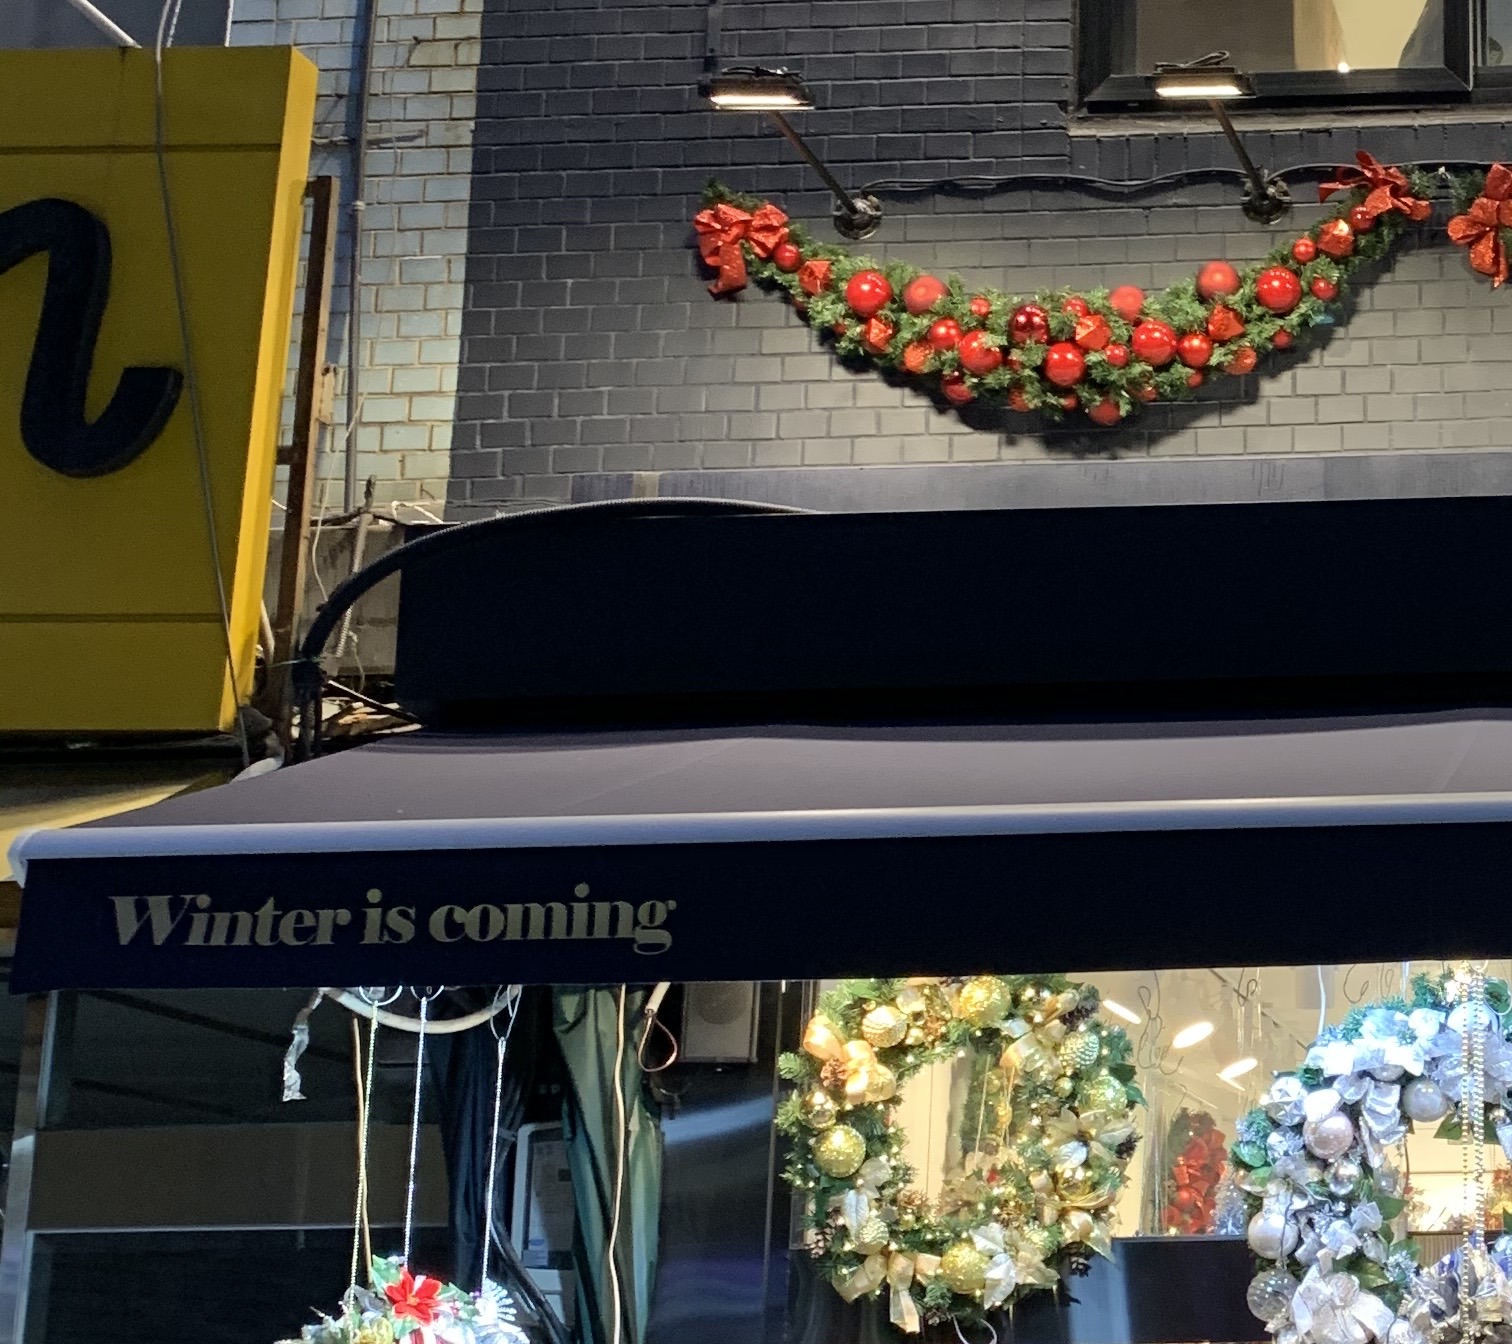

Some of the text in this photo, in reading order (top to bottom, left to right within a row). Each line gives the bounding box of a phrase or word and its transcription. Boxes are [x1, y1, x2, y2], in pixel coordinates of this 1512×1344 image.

[109, 883, 678, 957] Winter is coming
